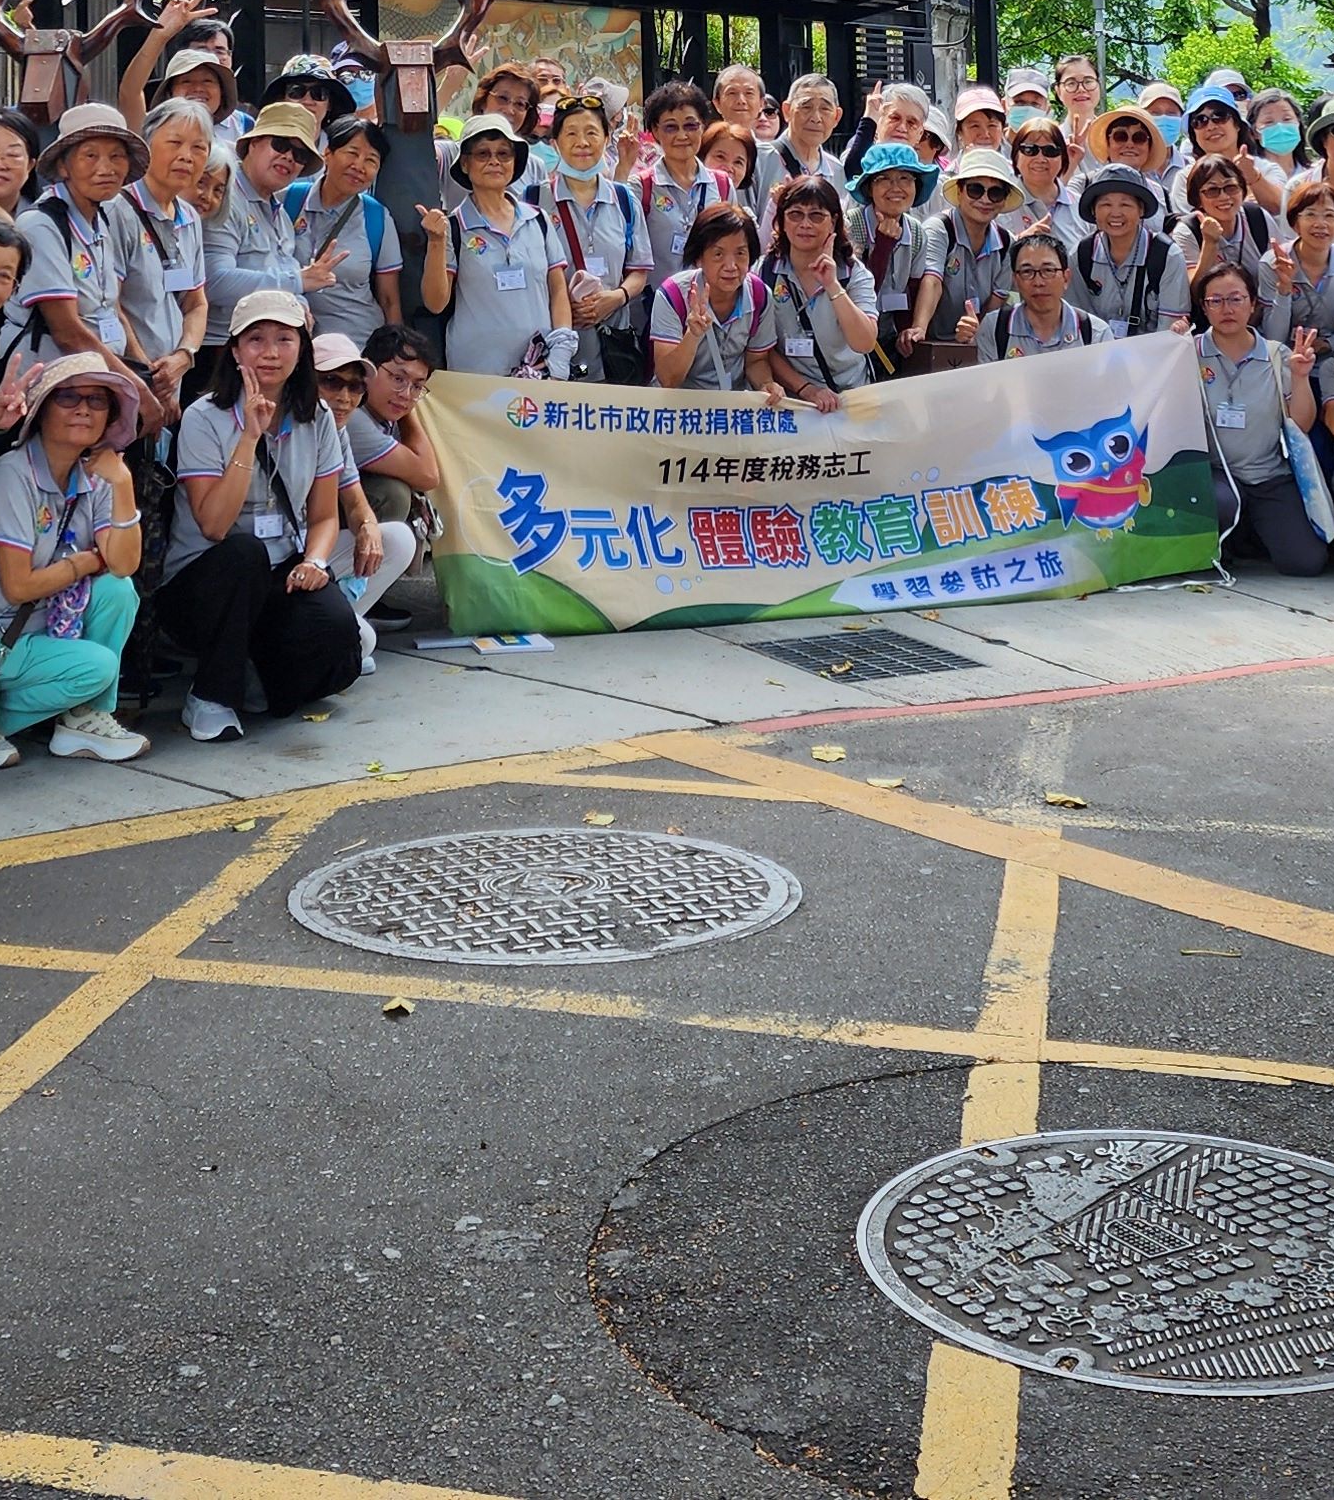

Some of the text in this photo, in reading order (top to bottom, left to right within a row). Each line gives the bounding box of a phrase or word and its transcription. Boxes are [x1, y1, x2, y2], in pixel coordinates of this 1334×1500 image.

[544, 400, 798, 436] 新北市政府稅捐稽徵處
[658, 450, 872, 485] 114年度稅務志工
[871, 549, 1066, 602] 學習參訪之旅
